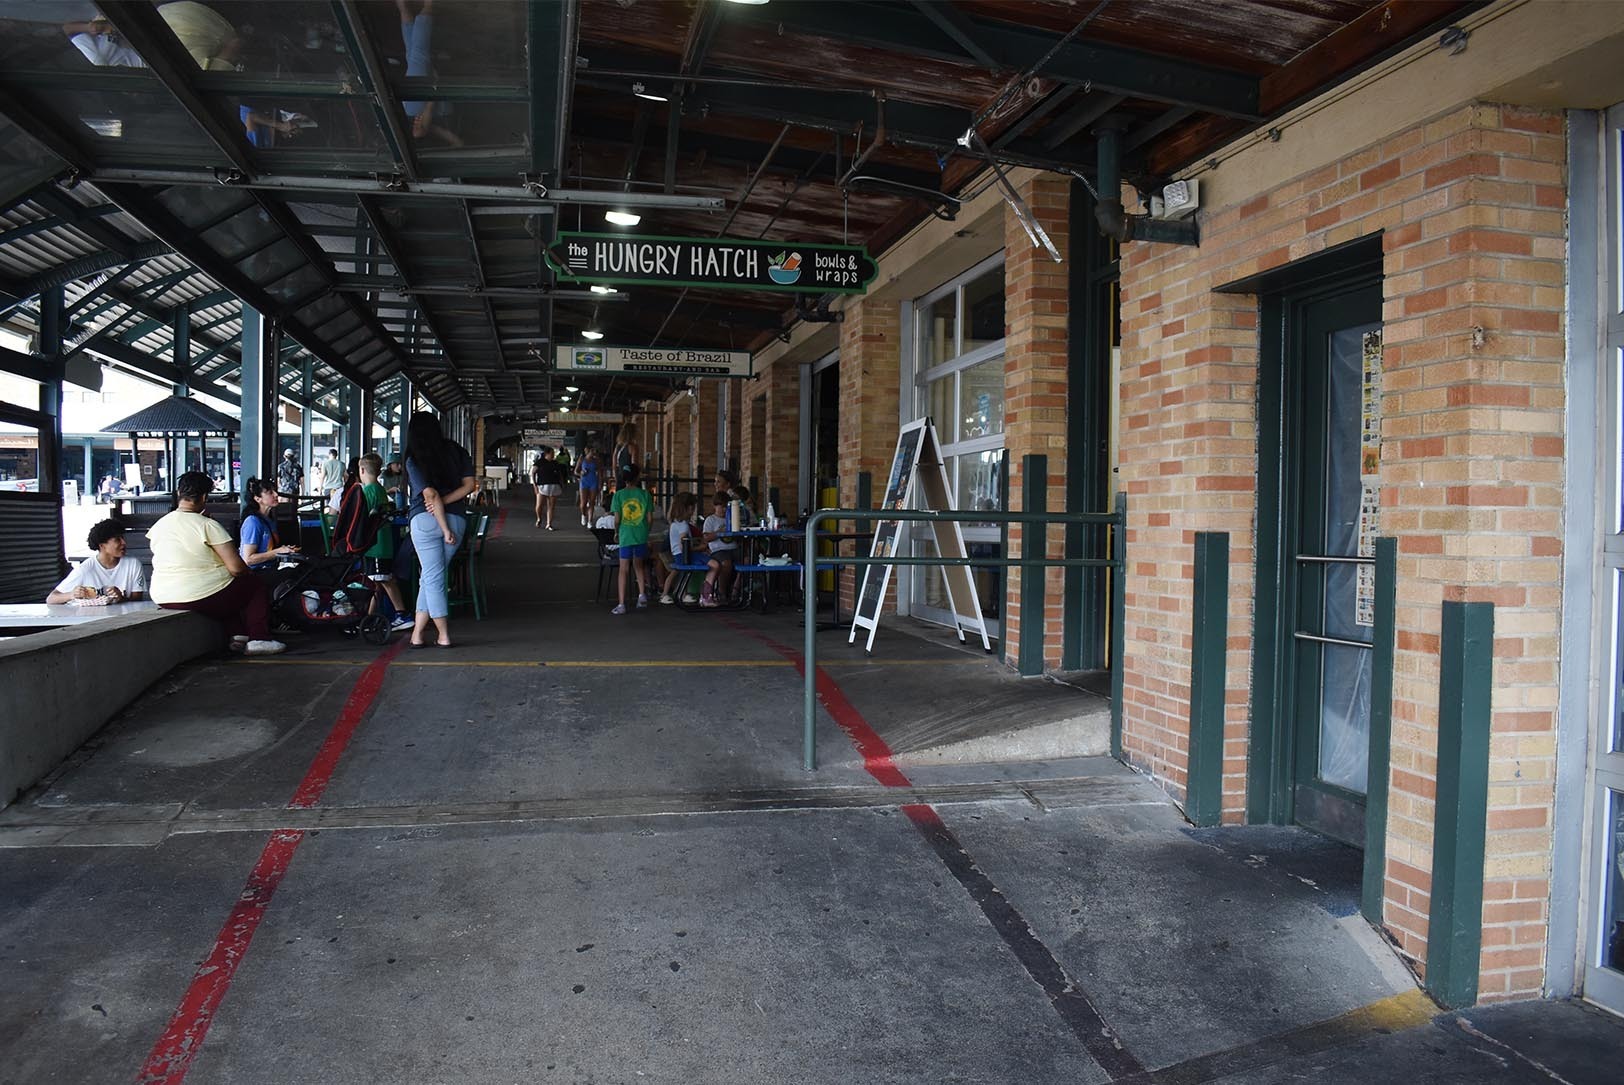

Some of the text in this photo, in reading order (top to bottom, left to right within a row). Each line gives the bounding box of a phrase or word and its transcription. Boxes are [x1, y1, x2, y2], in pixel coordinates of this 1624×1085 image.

[568, 242, 759, 279] the HUNGRY HATCH
[815, 269, 858, 286] wraps
[620, 349, 732, 364] Taste of Brazil
